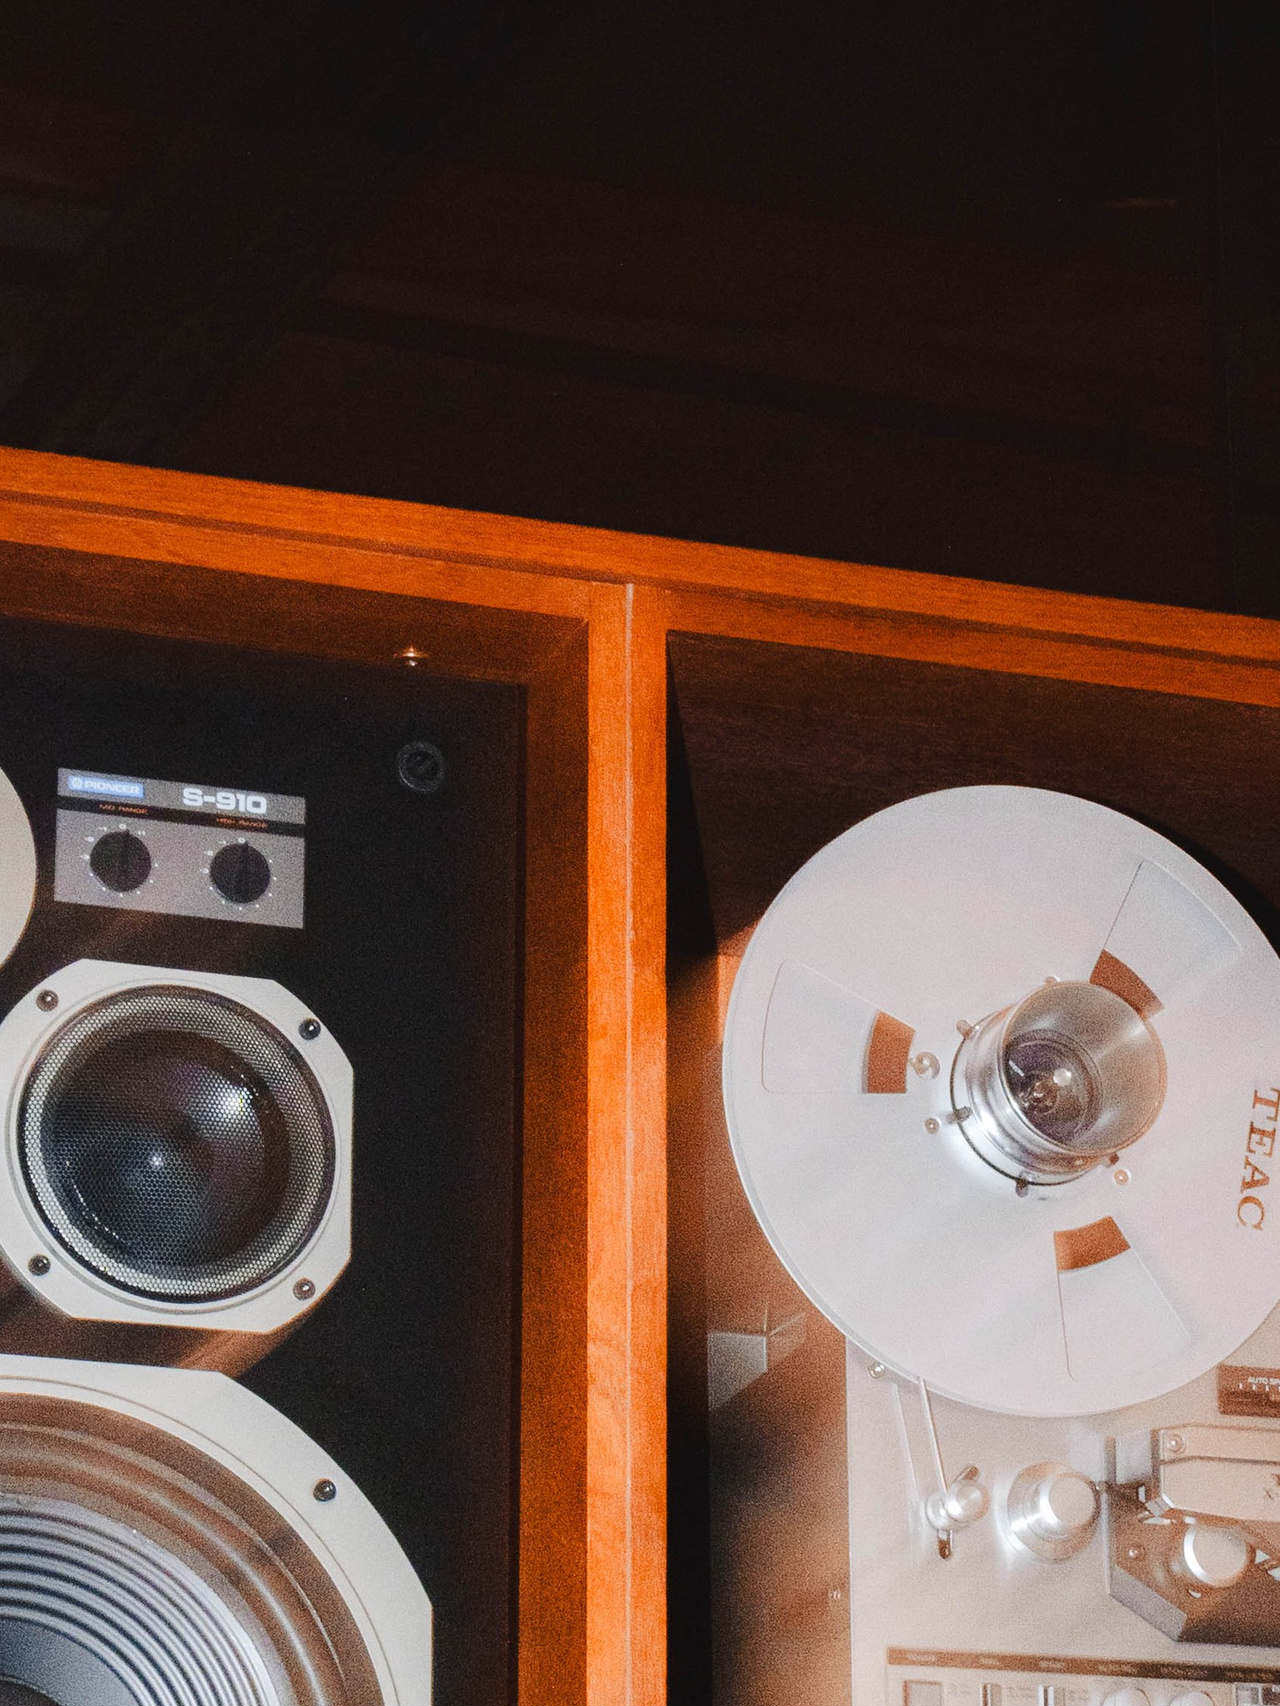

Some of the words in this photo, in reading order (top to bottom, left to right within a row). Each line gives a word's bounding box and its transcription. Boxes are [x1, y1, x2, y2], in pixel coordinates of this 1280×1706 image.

[84, 779, 141, 795] PIONEER
[182, 787, 267, 814] S-910
[1248, 1377, 1269, 1385] AUTO
